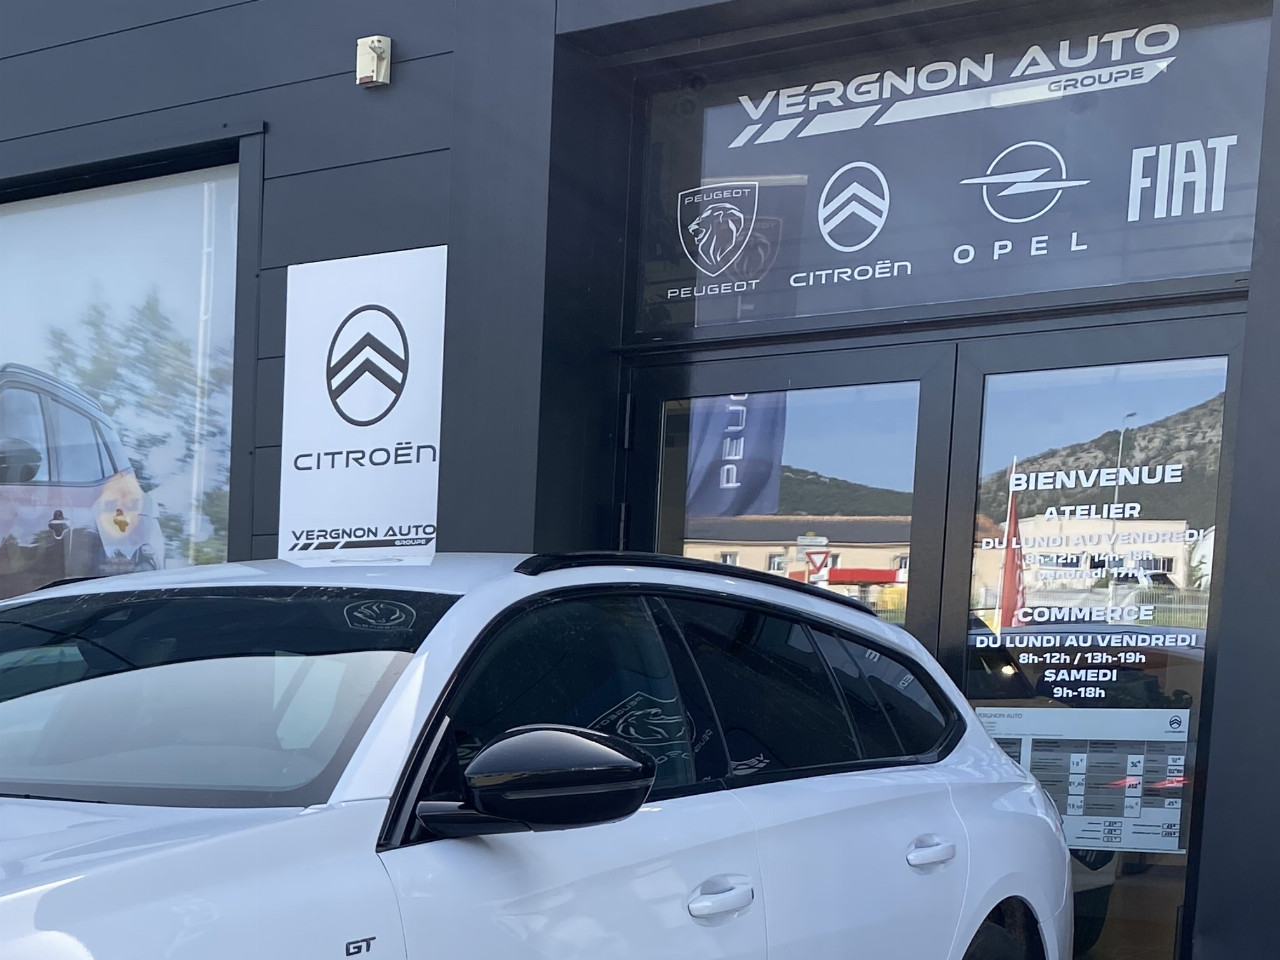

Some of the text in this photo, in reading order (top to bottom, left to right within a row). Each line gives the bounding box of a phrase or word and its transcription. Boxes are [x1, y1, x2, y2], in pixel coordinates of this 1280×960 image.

[738, 23, 1180, 120] VERGNON AUTO
[1047, 67, 1145, 93] GROUPE
[1127, 135, 1238, 222] FIAT
[685, 189, 751, 205] PEUGEOT
[953, 232, 1089, 264] OPEL
[667, 280, 760, 299] PEUGEOT
[1009, 464, 1183, 492] BIENVENUE
[1043, 502, 1142, 522] ATELIER
[291, 524, 437, 541] VERGNON AUTO
[981, 529, 1205, 550] DU LUNDI AU VENDREDI
[1017, 605, 1155, 623] COMMERCE
[976, 633, 1197, 648] DU LUNDI AU VENDREDI
[1019, 652, 1146, 666] 8h-12h / 13h-19h
[1044, 668, 1117, 682] SAMEDI
[1053, 686, 1106, 699] 9h-18h
[346, 936, 377, 957] GT
